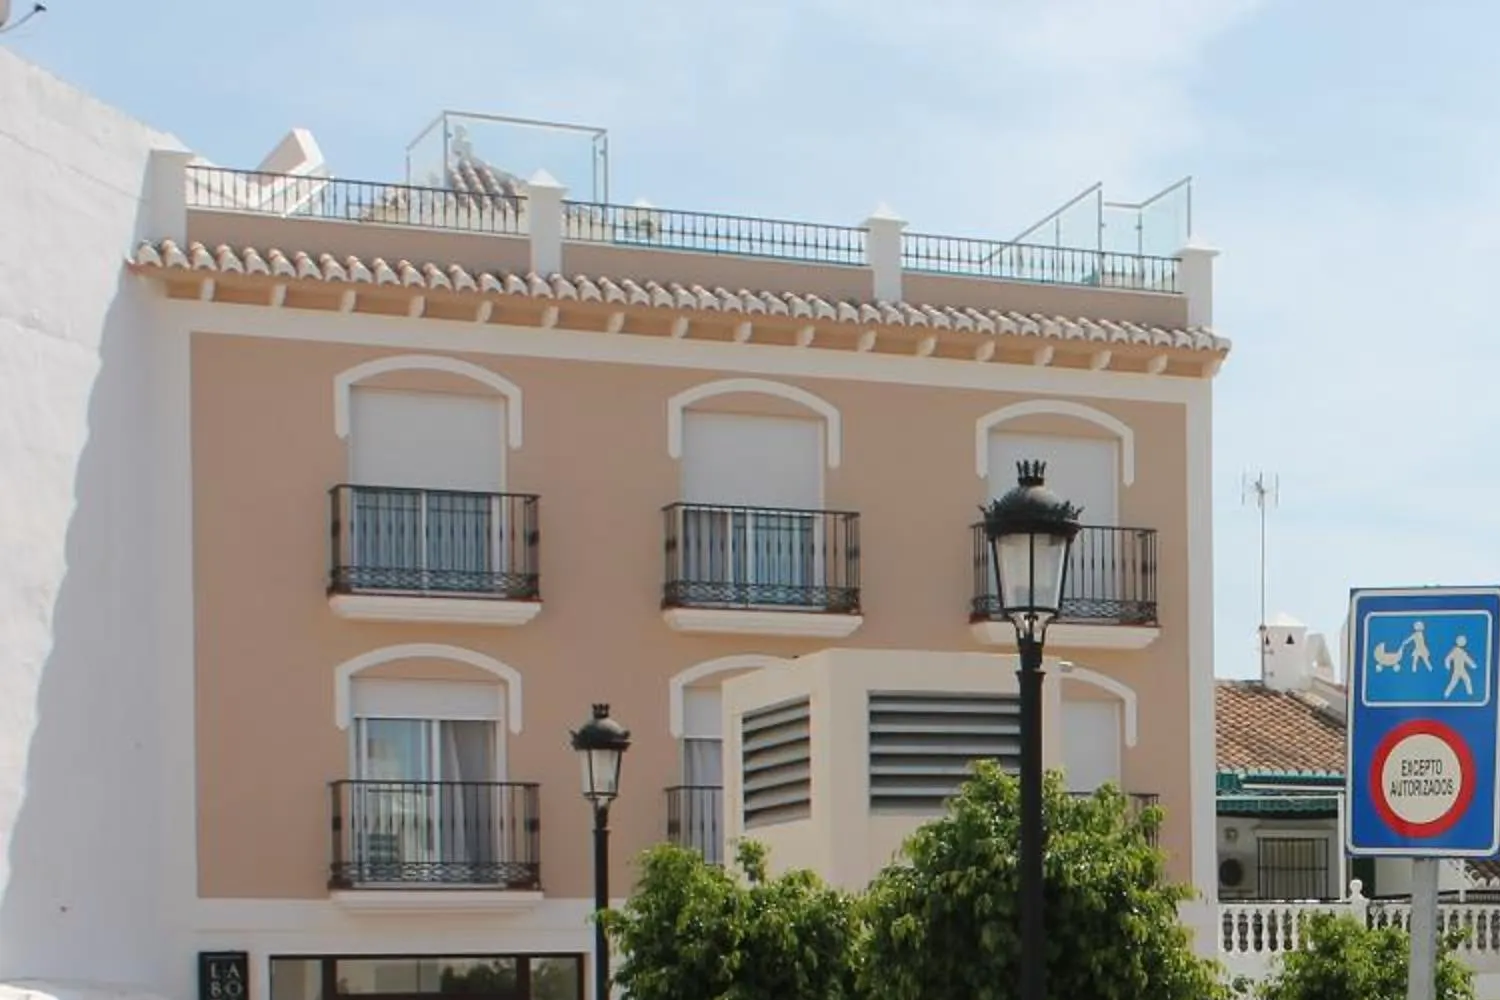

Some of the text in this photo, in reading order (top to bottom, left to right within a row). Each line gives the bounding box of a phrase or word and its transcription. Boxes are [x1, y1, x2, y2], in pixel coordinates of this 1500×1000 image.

[1401, 759, 1443, 777] EXCEPTO
[1390, 778, 1453, 797] AUTORIZADOS
[209, 961, 241, 979] LA
